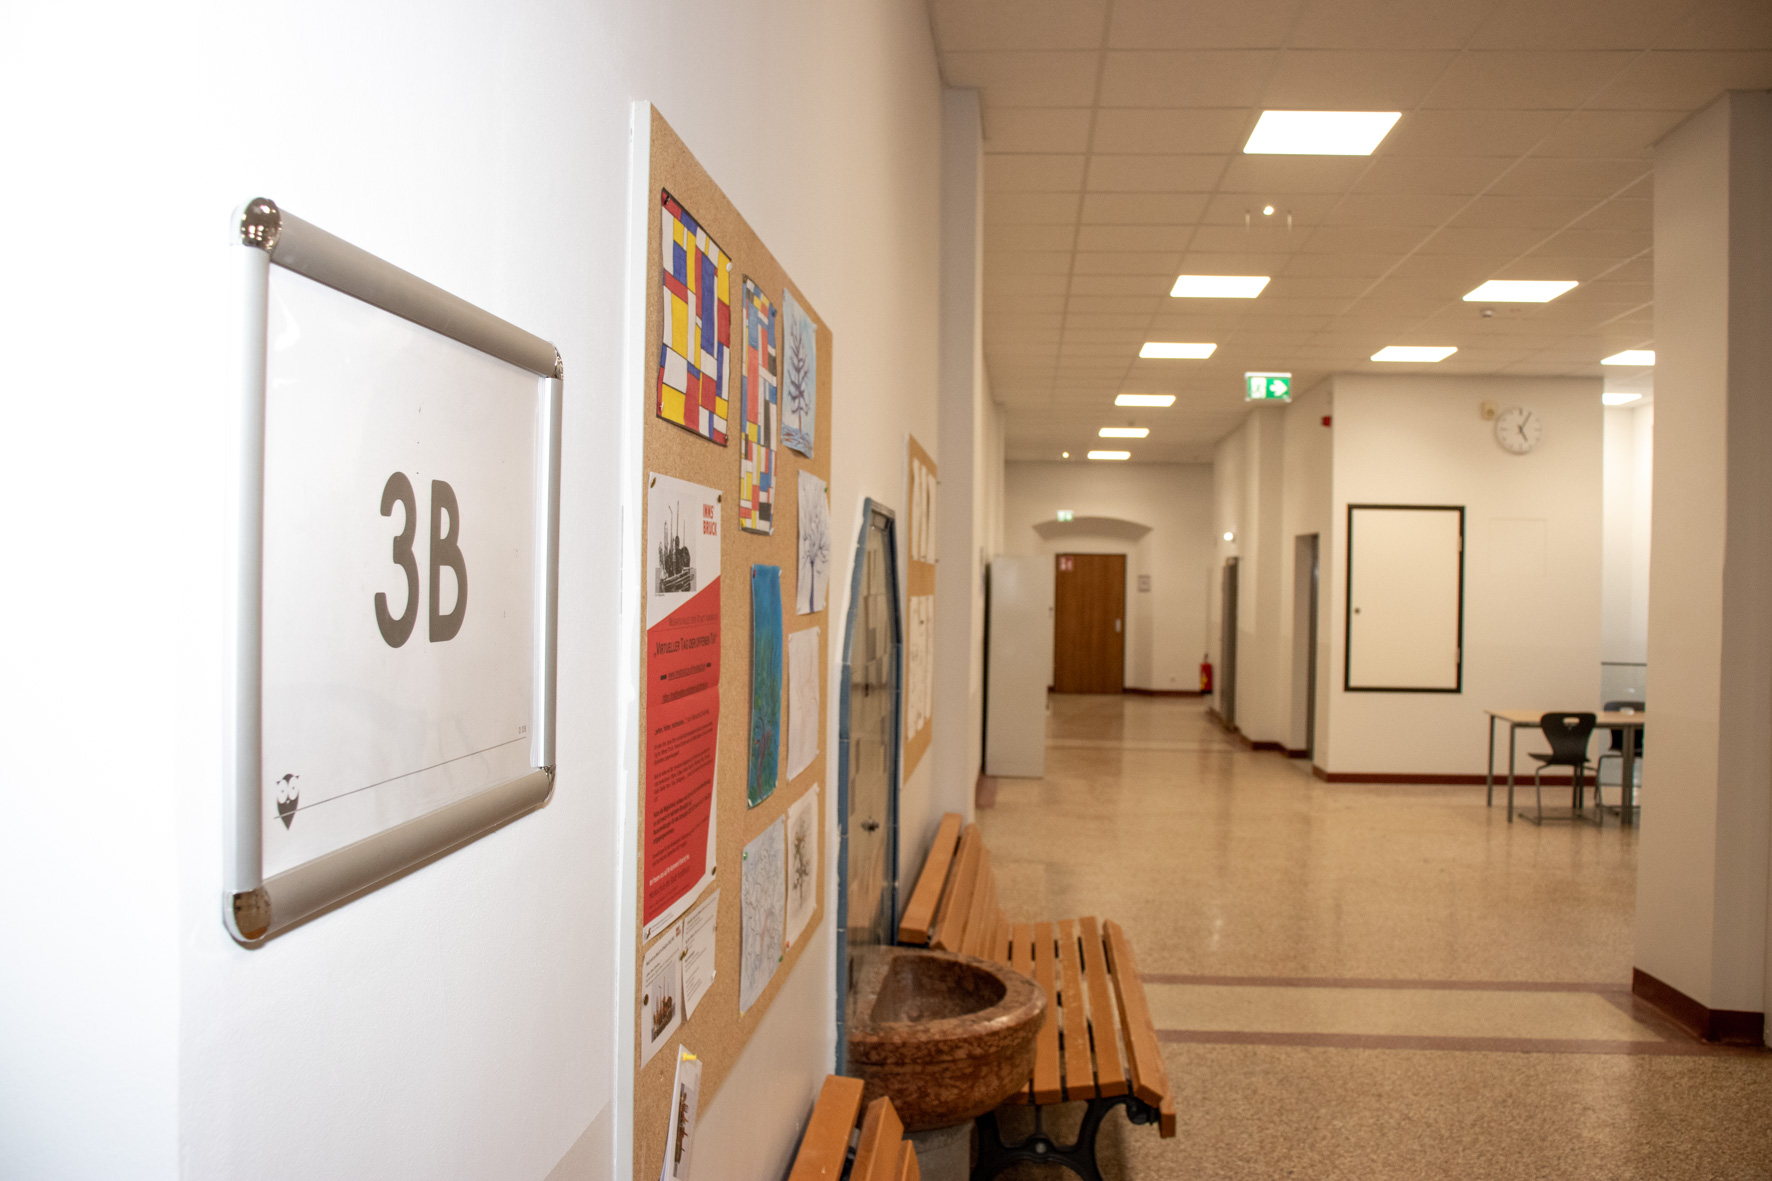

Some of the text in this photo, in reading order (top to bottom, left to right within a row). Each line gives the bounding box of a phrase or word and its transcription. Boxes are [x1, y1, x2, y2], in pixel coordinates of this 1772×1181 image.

[703, 504, 714, 519] INNS
[703, 520, 718, 536] BRUCK
[374, 471, 468, 649] 3B
